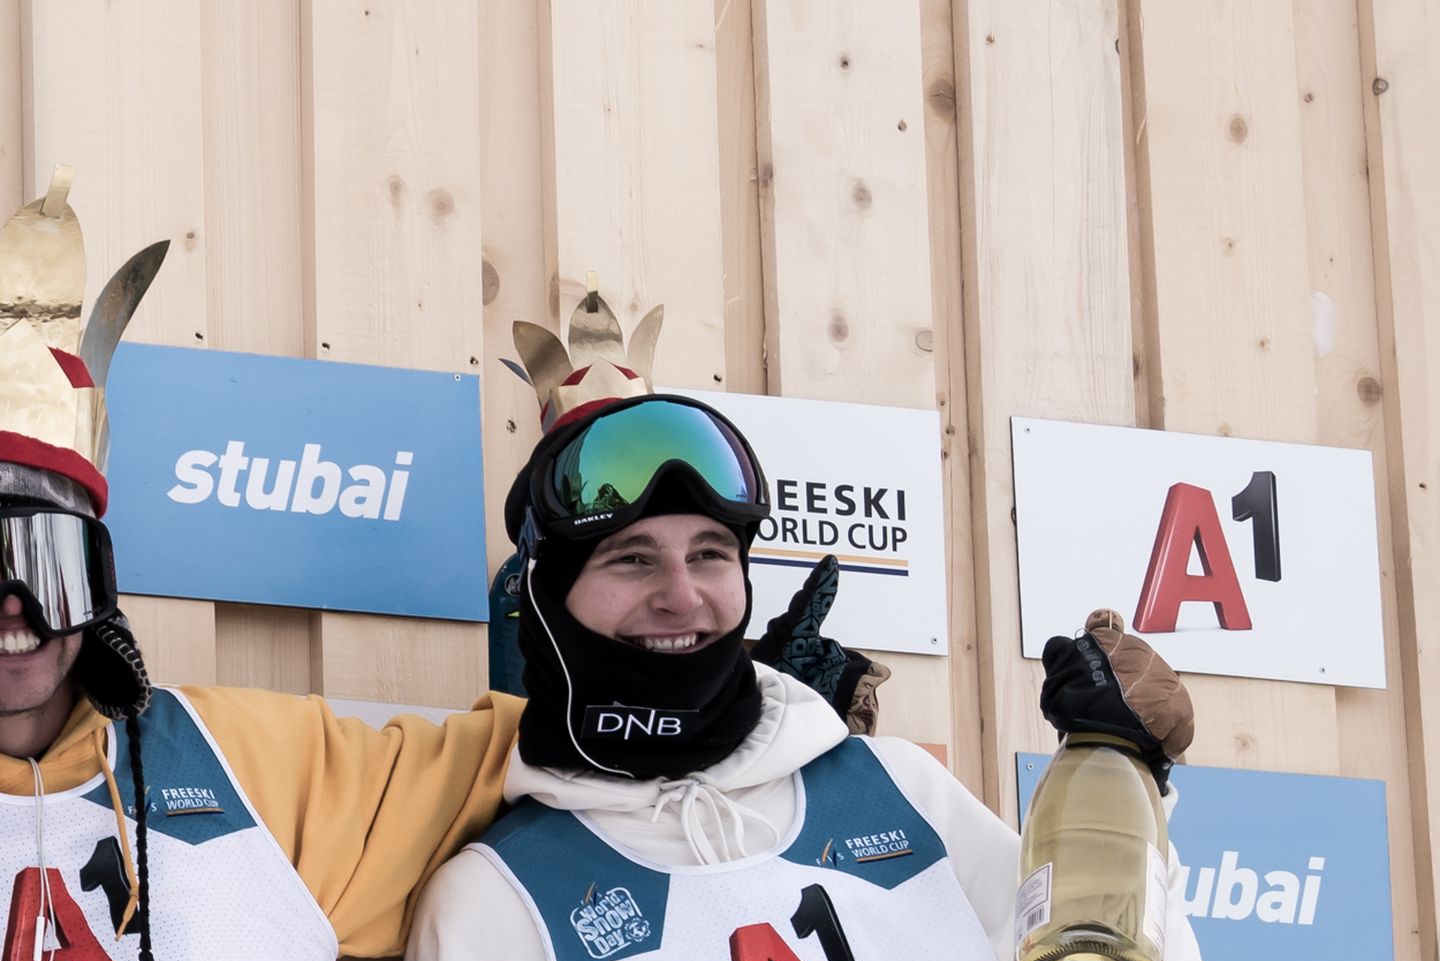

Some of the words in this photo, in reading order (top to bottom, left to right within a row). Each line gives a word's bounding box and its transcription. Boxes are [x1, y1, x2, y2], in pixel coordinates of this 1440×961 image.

[166, 440, 413, 521] stubai
[777, 479, 906, 521] EESKI
[574, 513, 613, 526] OAKLEY
[757, 516, 839, 546] ORLD
[847, 523, 907, 552] CUP
[1132, 470, 1282, 634] A1
[597, 709, 682, 740] DNB
[161, 787, 216, 800] FREESKI
[166, 799, 203, 810] WORLD
[845, 829, 907, 850] FREESKI
[851, 844, 889, 858] WORLD
[888, 839, 910, 852] CUP
[1178, 850, 1326, 925] ubai
[593, 929, 625, 955] Day
